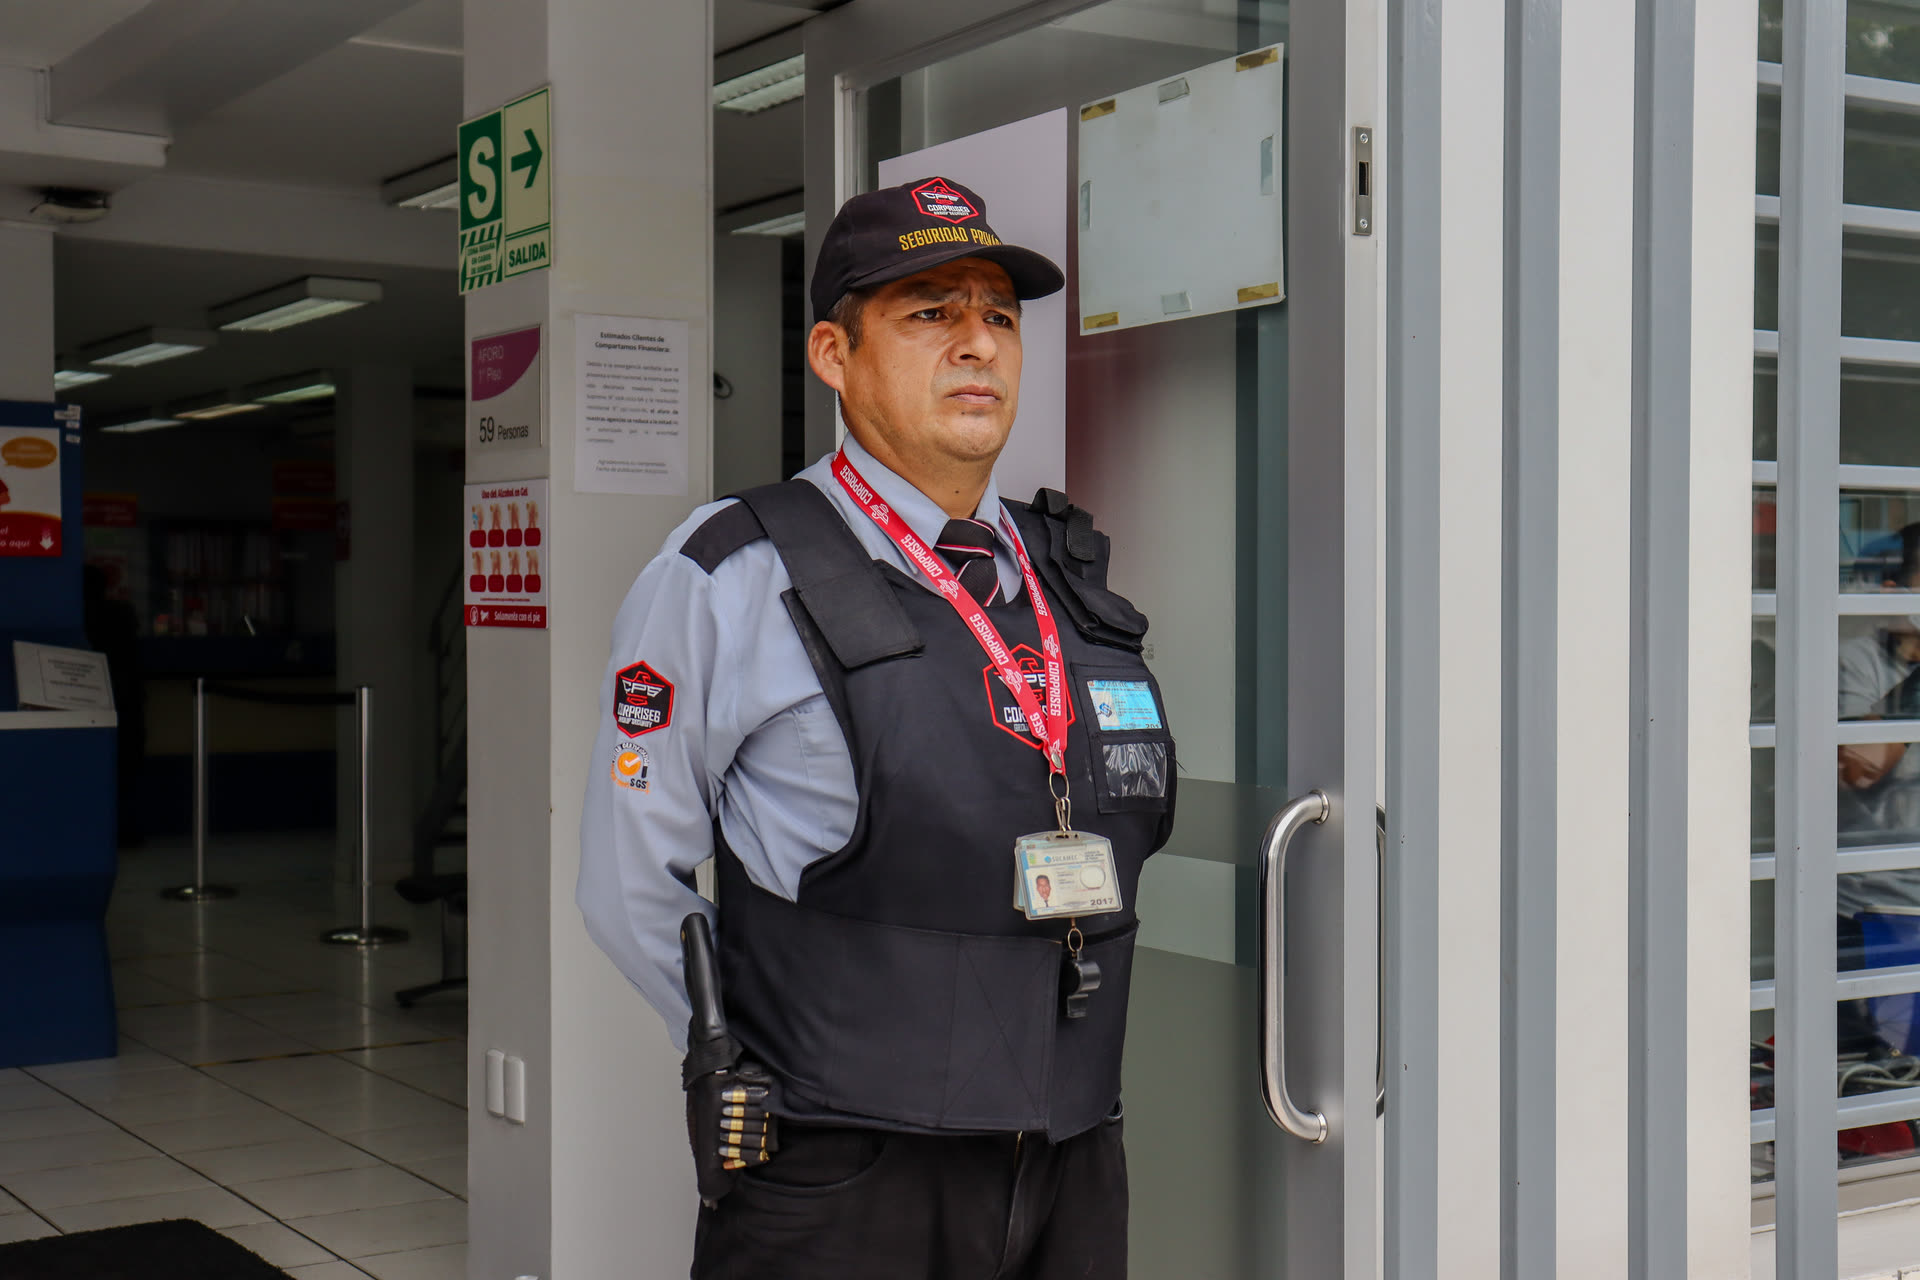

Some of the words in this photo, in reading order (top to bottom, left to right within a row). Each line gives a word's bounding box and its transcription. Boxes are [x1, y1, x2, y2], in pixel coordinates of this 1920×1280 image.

[467, 135, 497, 220] S
[898, 226, 969, 251] SEGURIDAD
[508, 241, 546, 268] SALIDA
[600, 331, 631, 341] Estimados
[632, 334, 656, 343] Clientes
[479, 416, 495, 443] 59
[497, 424, 529, 441] Personas
[839, 464, 874, 505] CORPRISEG
[900, 533, 943, 578] CORPRISEG
[968, 613, 1010, 666] CORPRISEG
[1047, 661, 1062, 717] CORPRISEG
[629, 778, 648, 790] SGS
[1089, 897, 1114, 906] 2017
